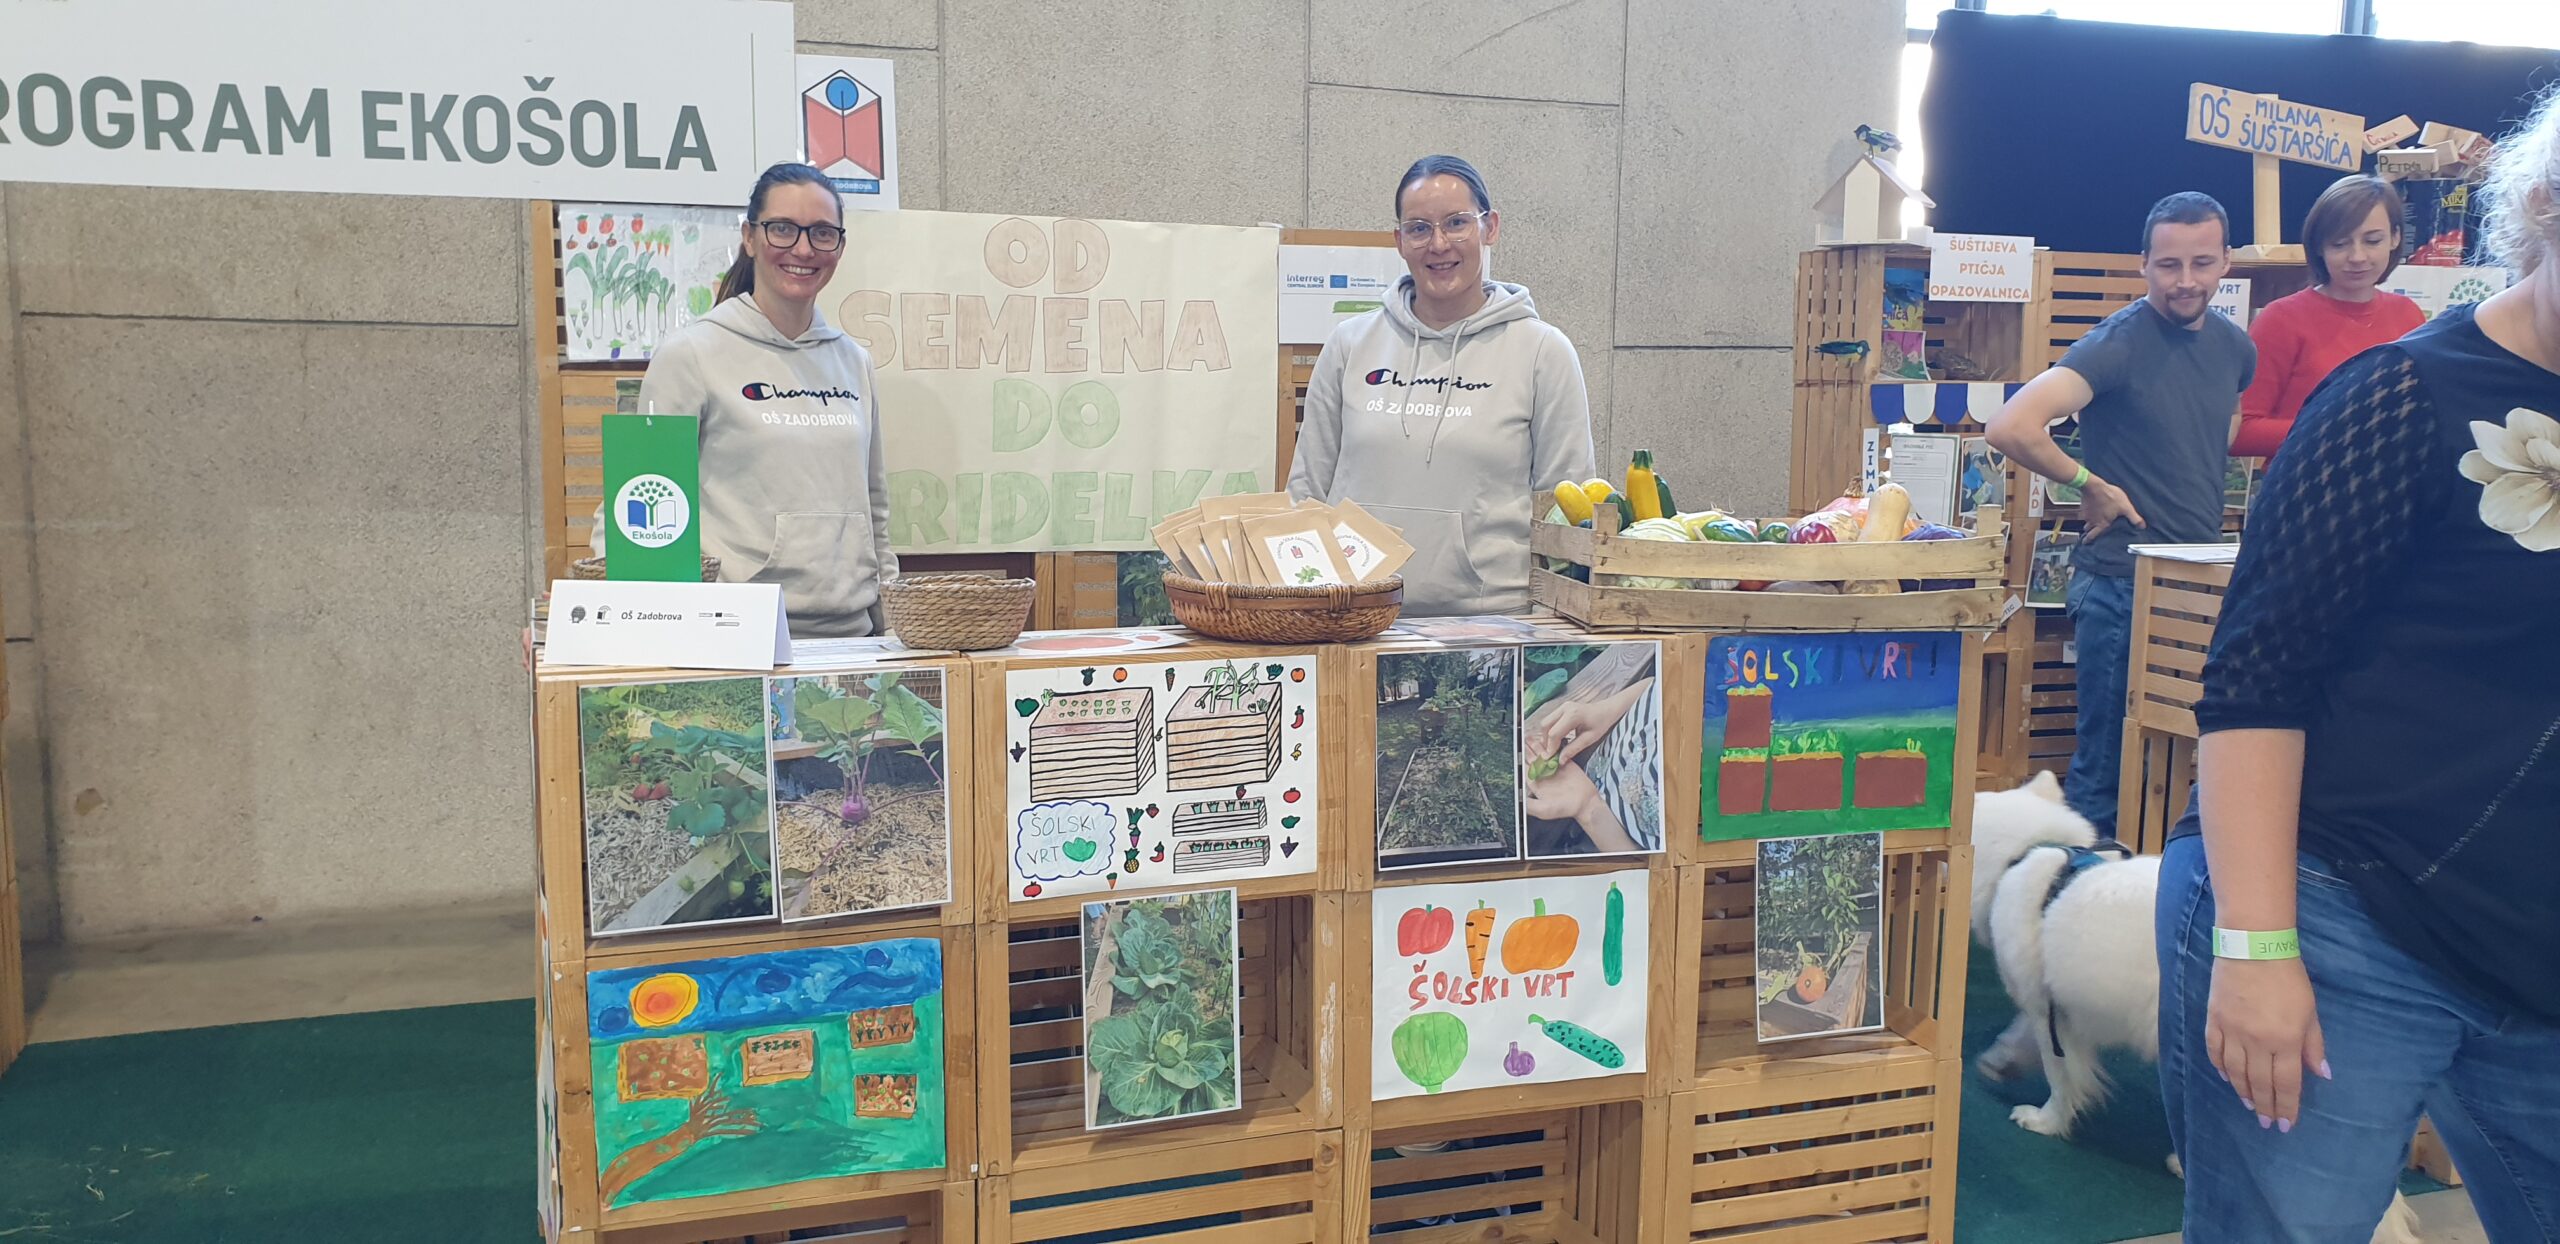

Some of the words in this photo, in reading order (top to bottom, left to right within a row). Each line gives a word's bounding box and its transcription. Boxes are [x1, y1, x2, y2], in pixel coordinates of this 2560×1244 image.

[0, 72, 331, 157] OGRAM
[361, 76, 717, 172] EKOŠOLA
[2199, 89, 2231, 139] OŠ
[2255, 99, 2323, 128] MILANA
[1950, 236, 2018, 254] ŠUŠTIJEVA
[984, 217, 1110, 294] OD
[1959, 261, 2006, 276] PTIČJA
[1930, 285, 2030, 299] OPAZOVALNICA
[839, 290, 1232, 374] SEMENA
[1366, 398, 1385, 412] OŠ
[761, 411, 781, 424] OŠ
[992, 379, 1121, 453] DO
[632, 531, 673, 540] Ekošola
[621, 610, 633, 620] OŠ
[637, 612, 682, 621] Zadobrova
[1031, 812, 1097, 837] ŠOLSKI
[1026, 845, 1060, 865] VRT
[1408, 960, 1509, 1011] ŠOLSKI
[1523, 970, 1575, 998] VRT
